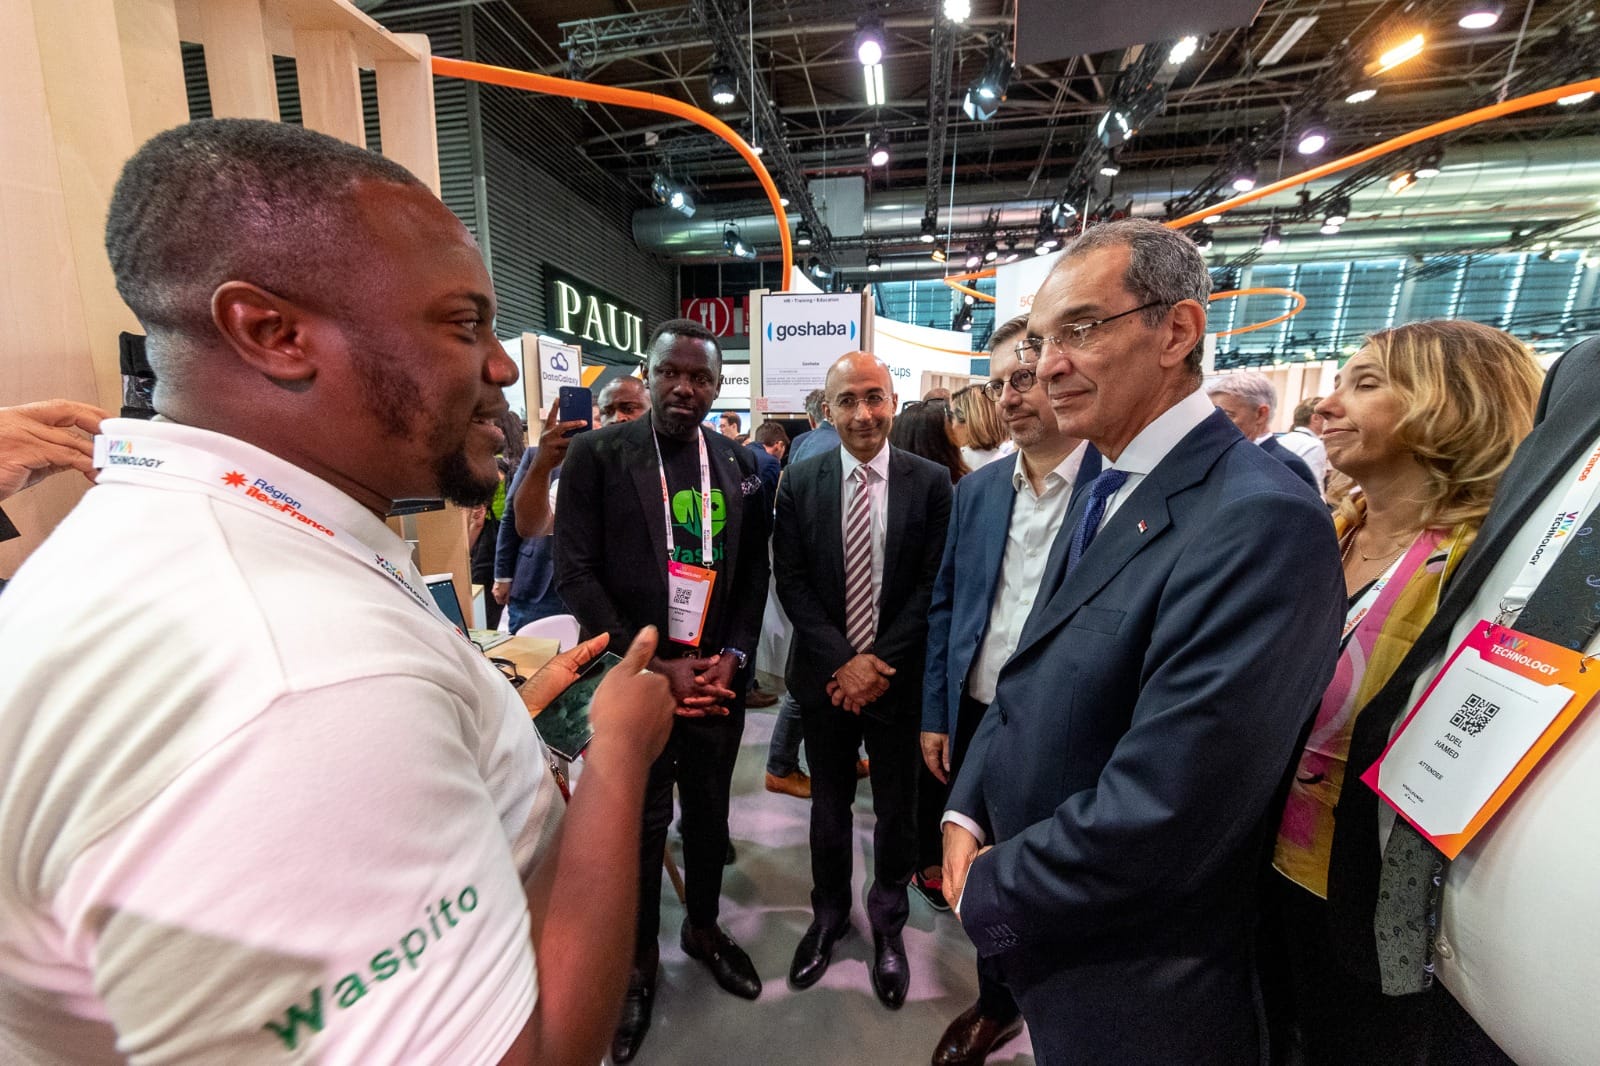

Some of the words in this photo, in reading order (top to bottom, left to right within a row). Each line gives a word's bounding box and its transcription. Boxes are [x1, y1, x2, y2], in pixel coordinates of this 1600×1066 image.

[554, 280, 648, 359] PAUL
[776, 321, 847, 341] goshaba
[542, 372, 579, 386] DataGalaxy
[1578, 448, 1600, 482] rance
[253, 478, 302, 509] Région
[1529, 511, 1567, 566] TECHNOLOGY
[1490, 643, 1560, 677] TECHNOLOGY
[1434, 740, 1460, 759] HAMED
[1444, 732, 1463, 748] ADEL
[262, 885, 478, 1051] Waspito
